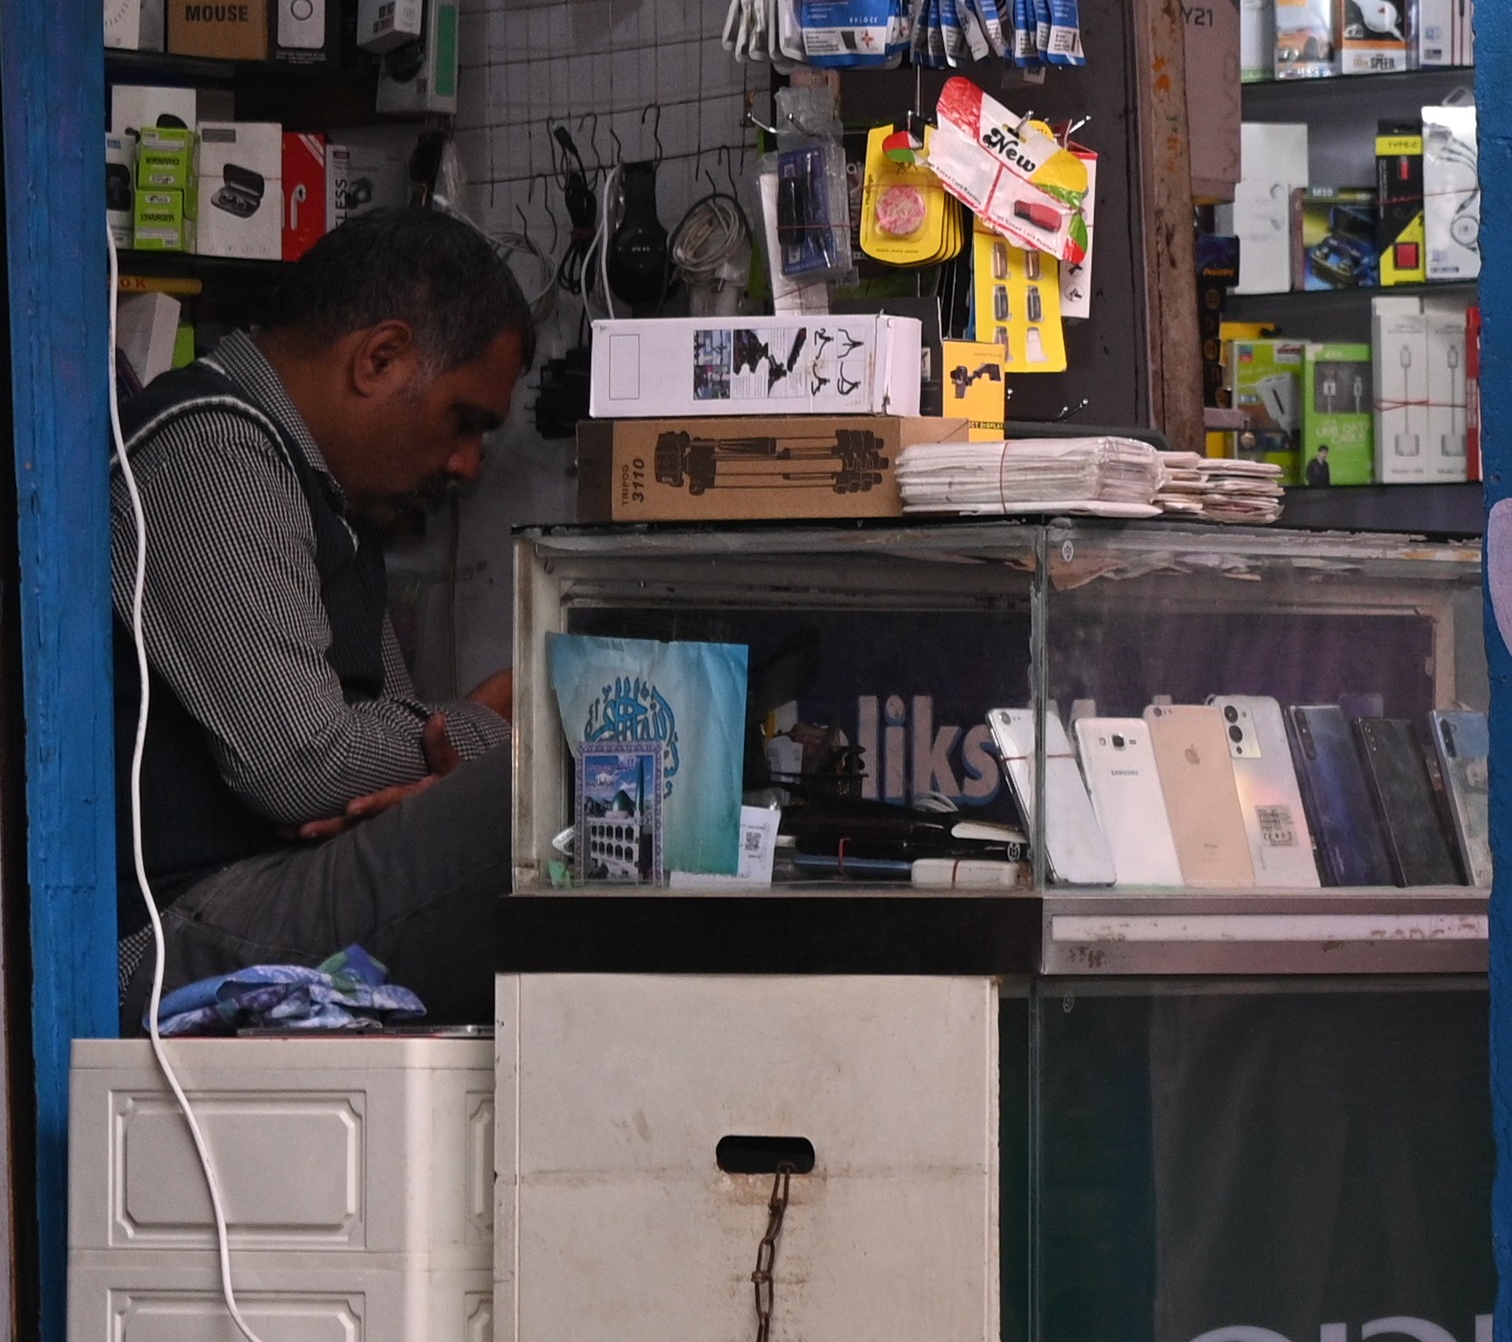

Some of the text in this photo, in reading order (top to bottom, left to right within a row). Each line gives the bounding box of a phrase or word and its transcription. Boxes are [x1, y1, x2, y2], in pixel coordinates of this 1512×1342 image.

[185, 4, 249, 22] MOUSE
[983, 127, 1036, 172] New
[622, 465, 630, 507] TRIPOD
[632, 458, 645, 504] 3110
